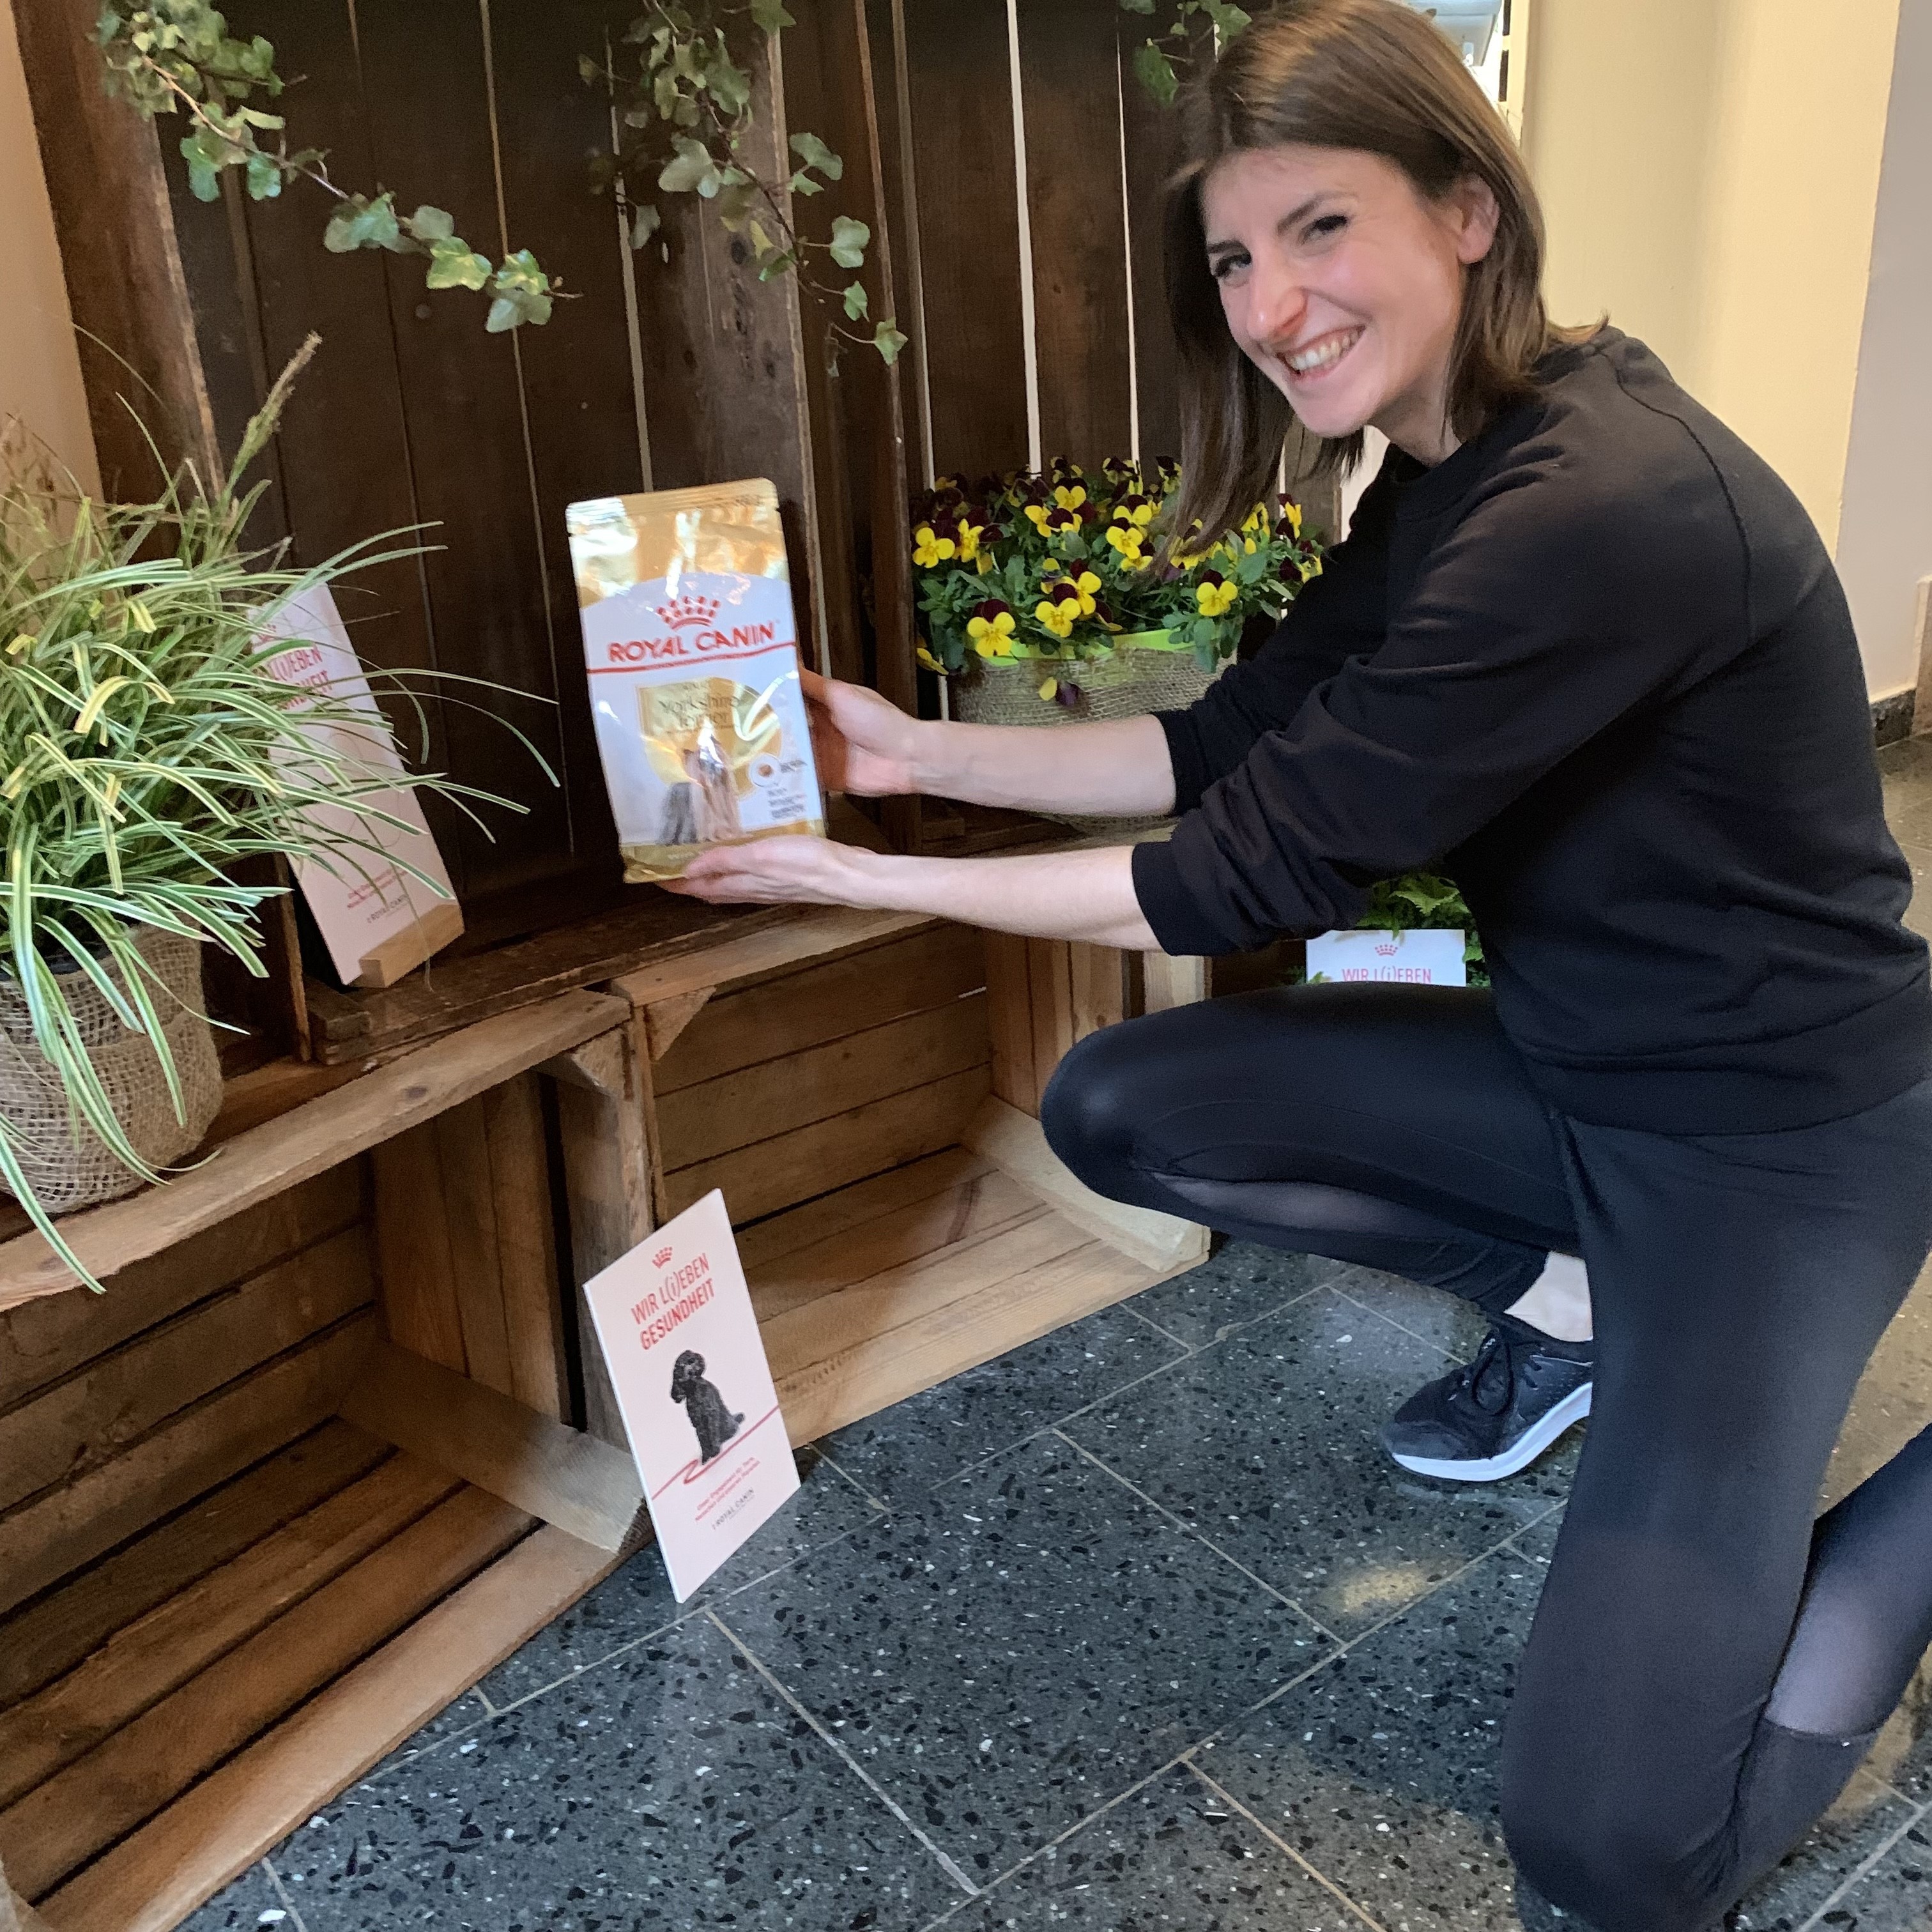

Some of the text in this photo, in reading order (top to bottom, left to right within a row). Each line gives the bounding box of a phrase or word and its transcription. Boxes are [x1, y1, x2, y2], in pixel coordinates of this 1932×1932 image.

[608, 621, 775, 662] ROYAL CANIN
[1342, 968, 1368, 981] WIR
[631, 1252, 710, 1324] WIR L(i)EBEN
[640, 1277, 714, 1350] GESUNDHEIT
